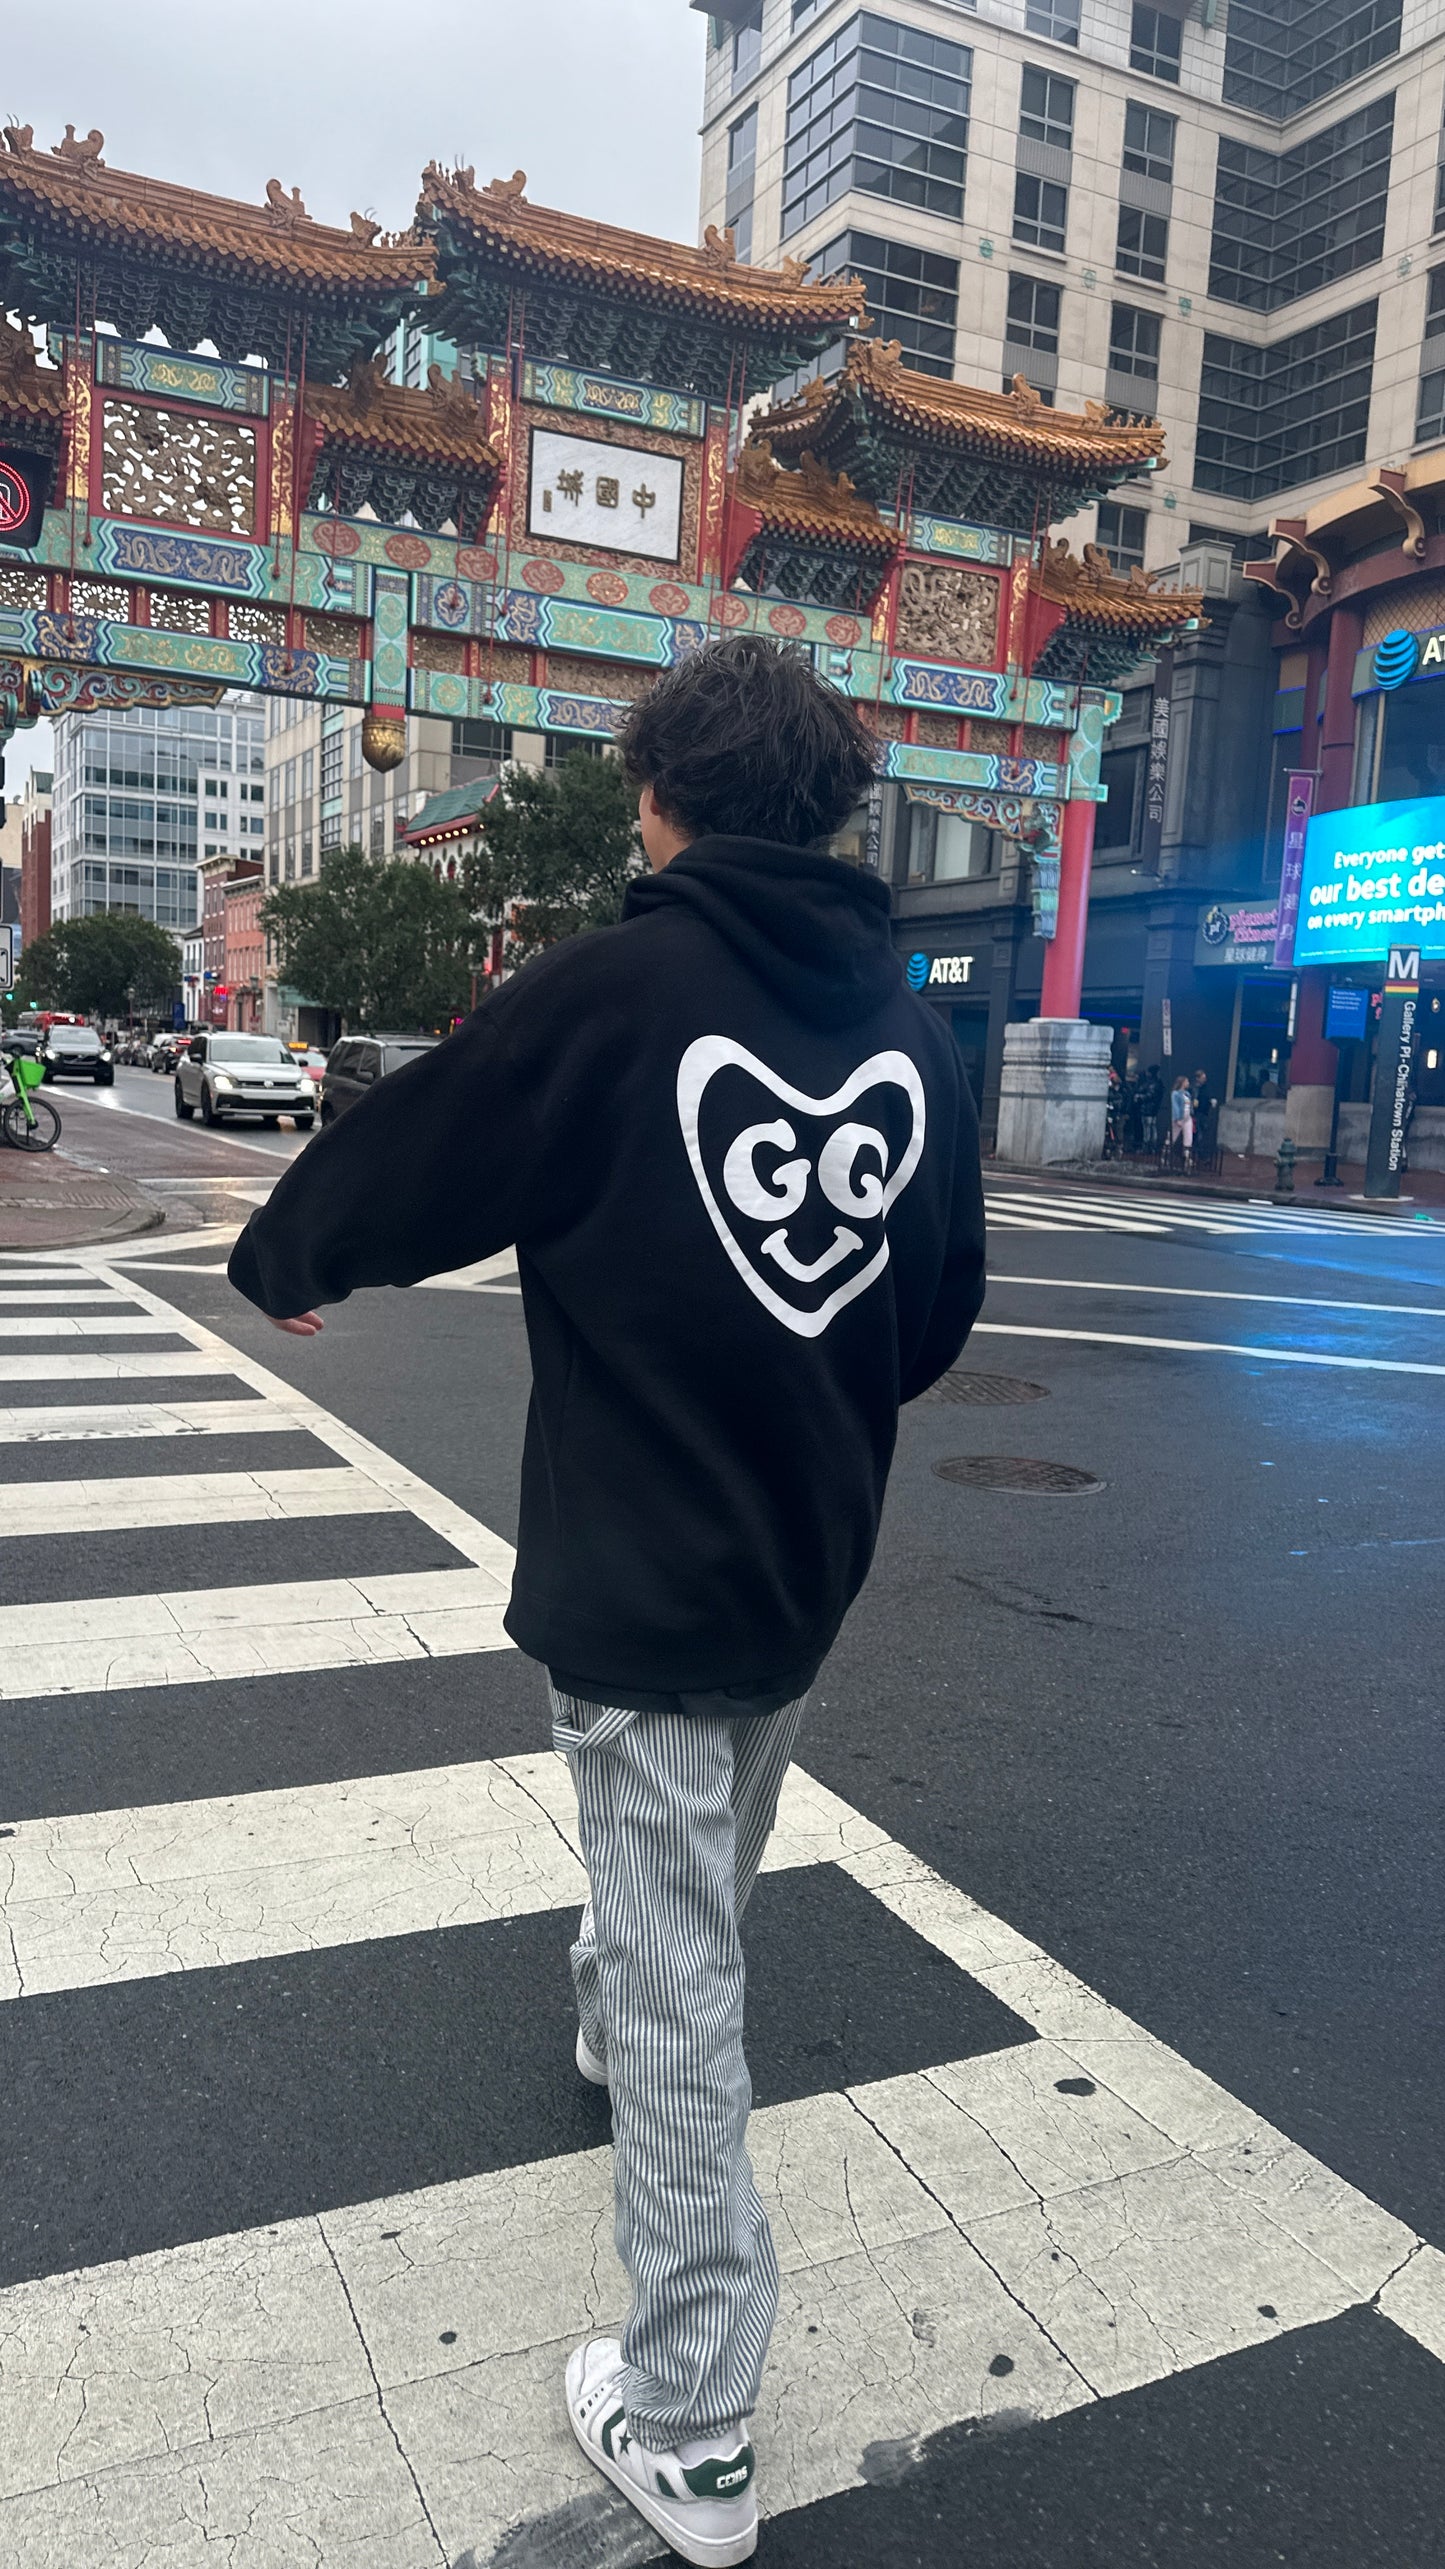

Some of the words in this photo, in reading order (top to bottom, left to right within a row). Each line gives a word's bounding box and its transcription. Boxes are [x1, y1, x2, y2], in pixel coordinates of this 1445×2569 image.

[1333, 847, 1408, 870] Everyone
[1309, 883, 1343, 907] our
[1346, 873, 1402, 901] best
[1307, 915, 1323, 930] on
[1324, 911, 1365, 930] every
[929, 956, 974, 984] AT&T
[1388, 950, 1420, 979] M
[1400, 1001, 1416, 1043] Gallery
[1388, 1129, 1404, 1171] Station
